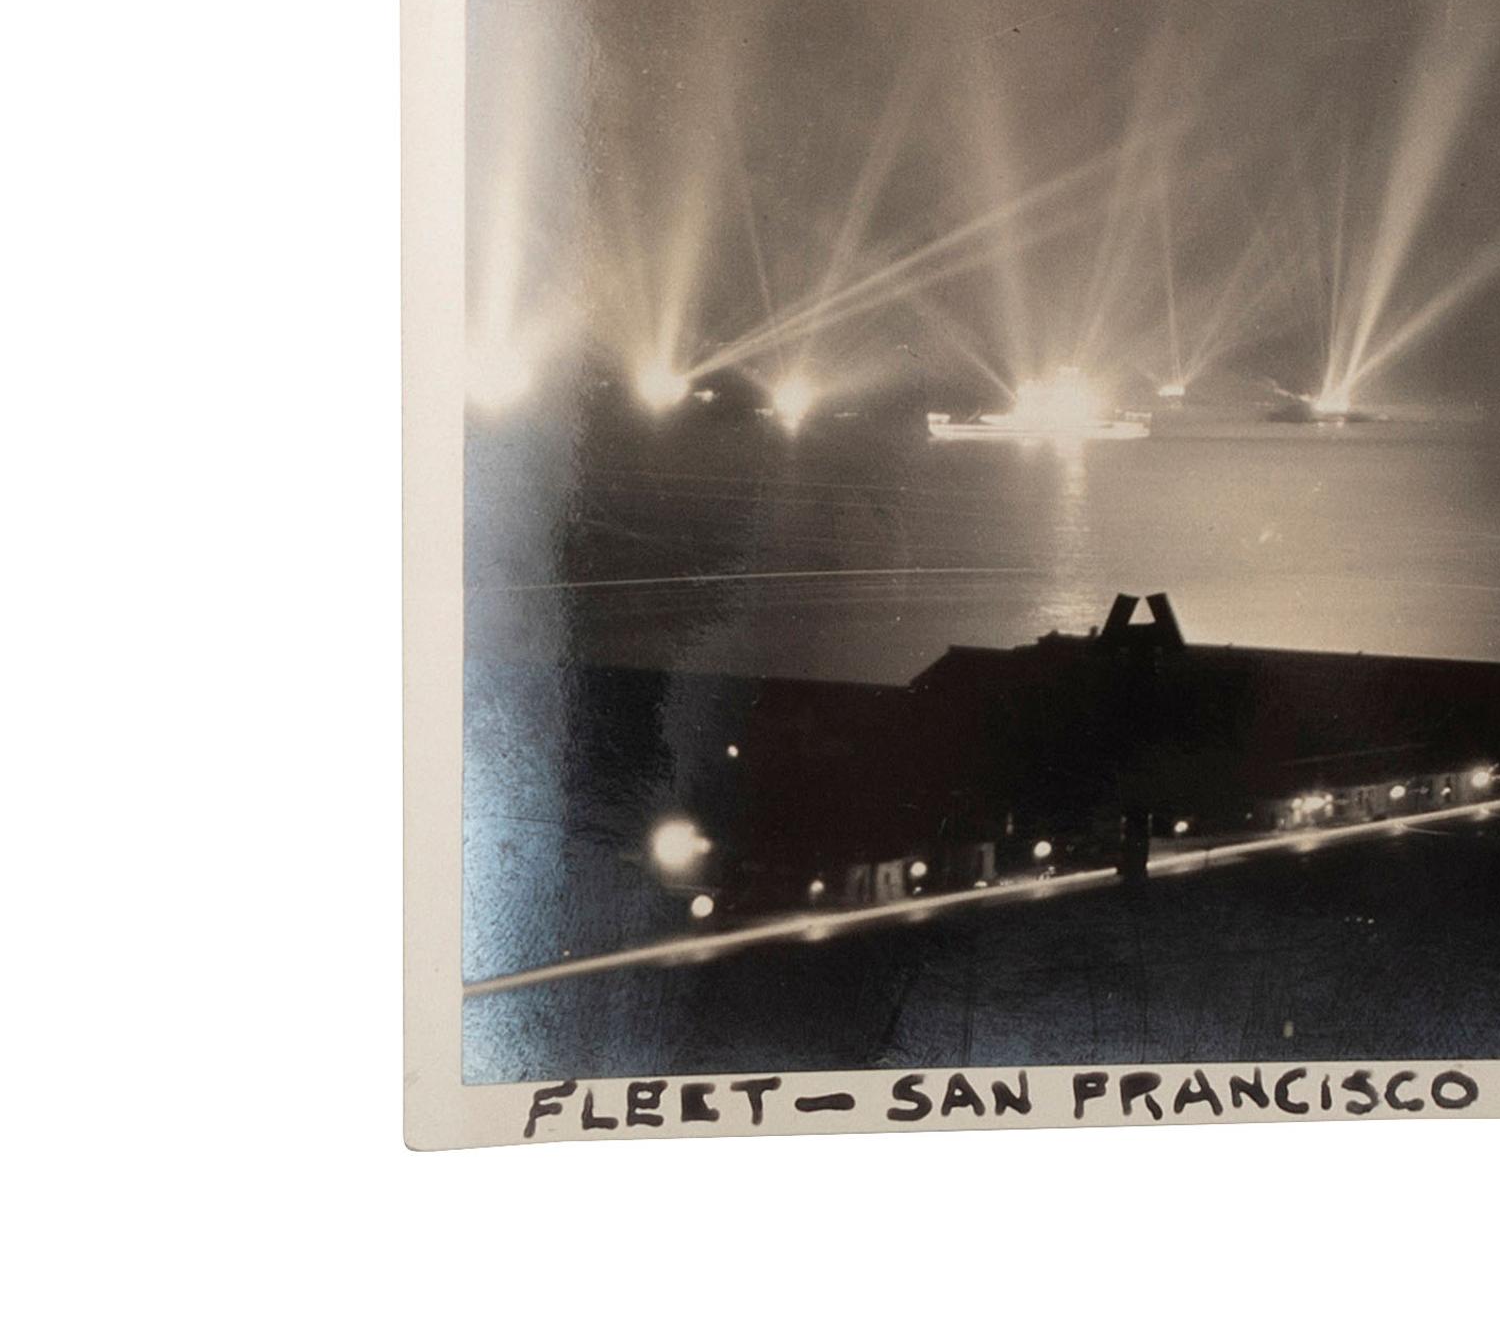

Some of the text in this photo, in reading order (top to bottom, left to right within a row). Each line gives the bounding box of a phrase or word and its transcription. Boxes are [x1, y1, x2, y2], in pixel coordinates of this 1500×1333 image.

[524, 1076, 782, 1139] FLEET
[886, 1072, 1033, 1122] SAN
[1072, 1067, 1480, 1122] FRANCISCO
